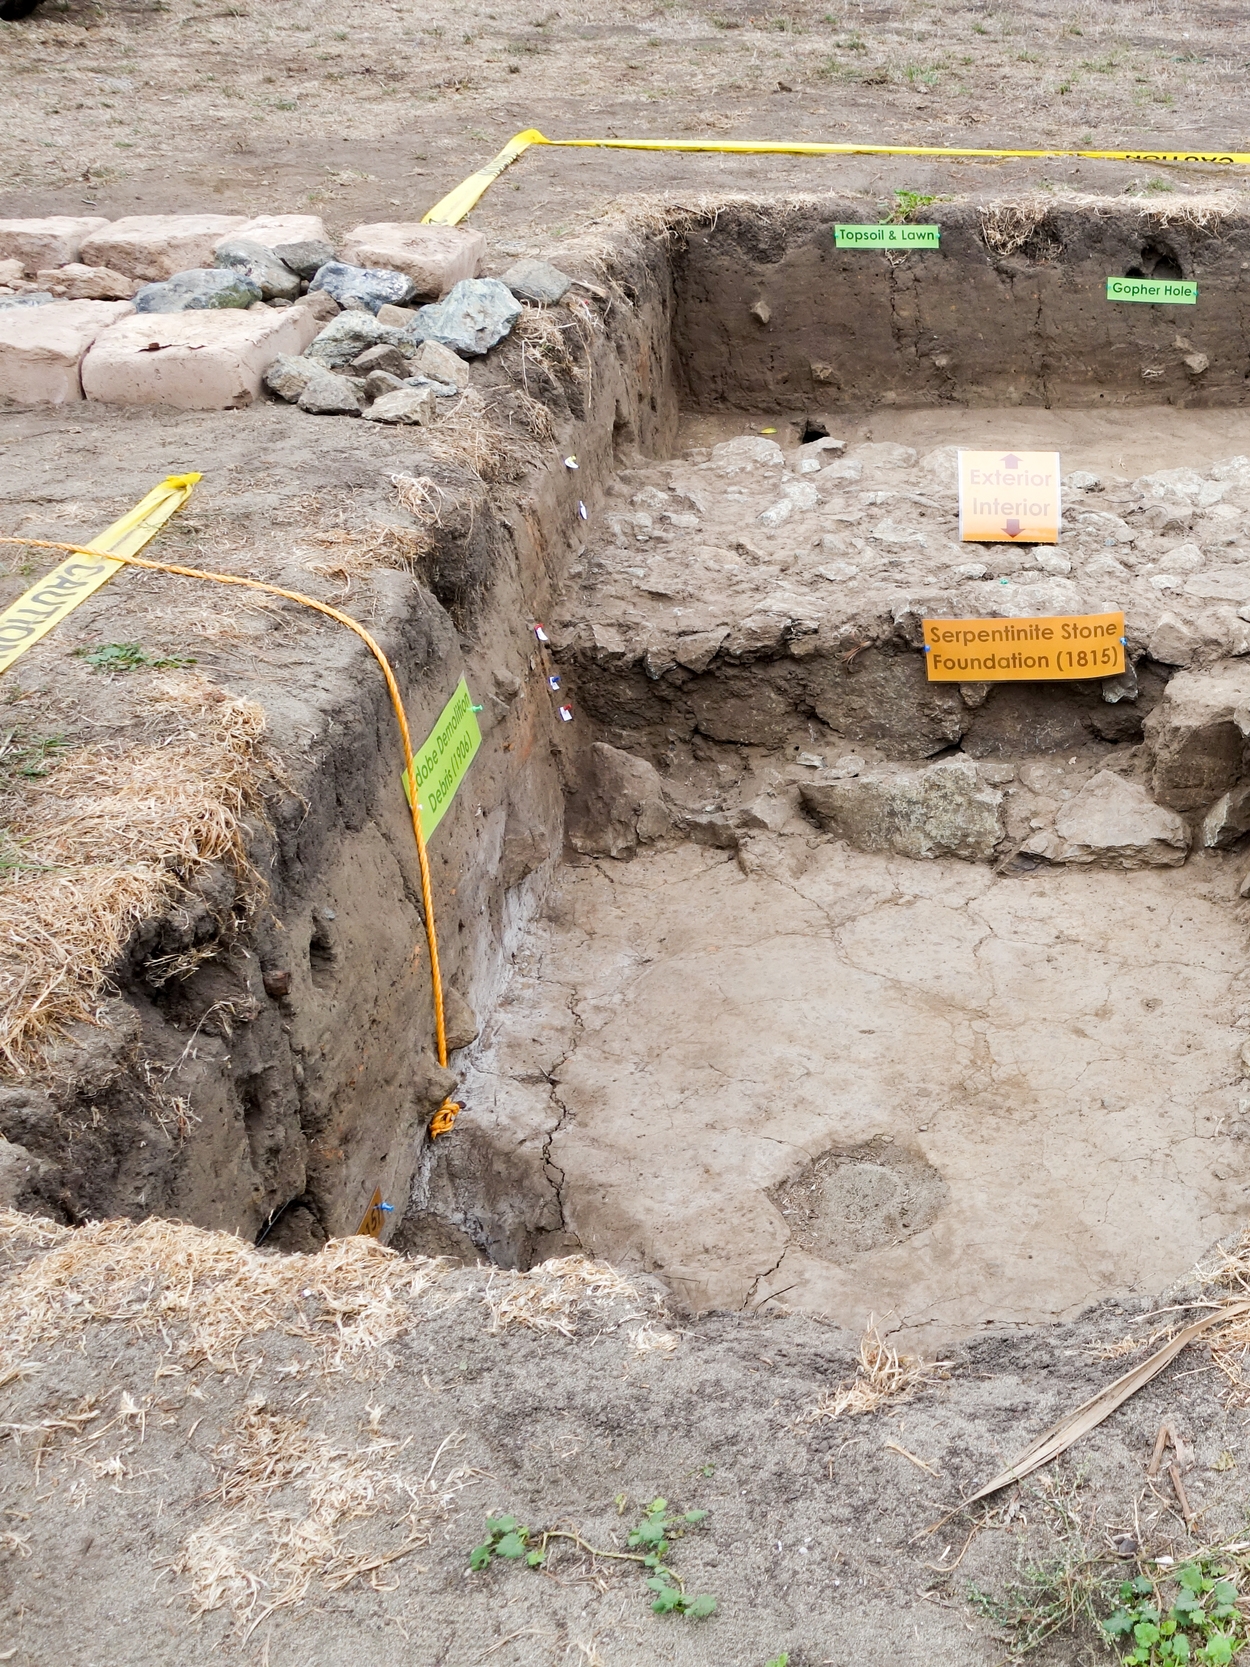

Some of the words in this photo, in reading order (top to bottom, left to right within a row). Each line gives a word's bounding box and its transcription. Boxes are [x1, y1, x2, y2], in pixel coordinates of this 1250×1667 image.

[840, 229, 884, 243] Topsoil
[888, 230, 897, 241] &
[901, 229, 935, 241] Lawn
[1112, 282, 1161, 297] Gopher
[1164, 285, 1192, 297] Hole
[970, 469, 1052, 487] Exterior
[973, 498, 1050, 516] Interior
[930, 624, 1054, 646] Serpentinite
[1061, 623, 1118, 640] Stone
[933, 651, 1049, 670] Foundation
[1056, 646, 1118, 671] (1815)
[415, 749, 439, 793] dobe
[436, 692, 470, 753] Demolition
[428, 768, 453, 814] Debris
[450, 730, 473, 777] (1906)
